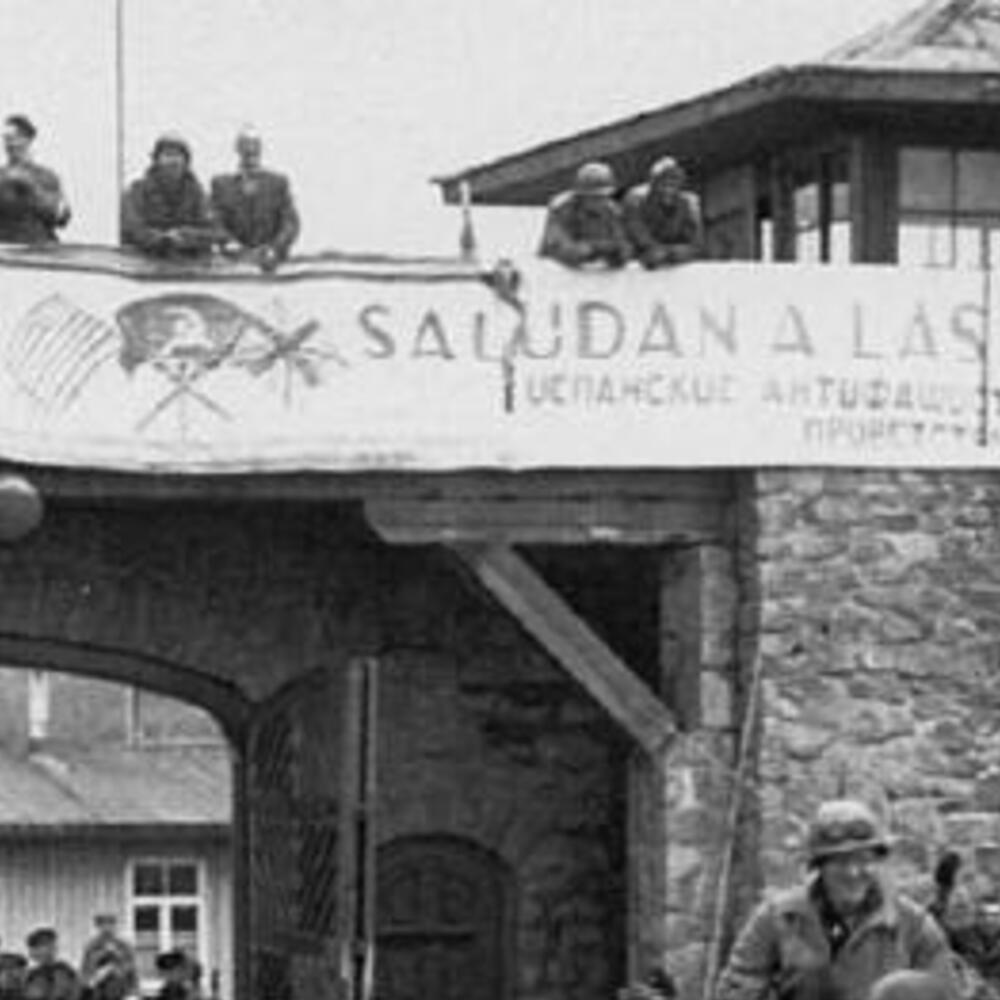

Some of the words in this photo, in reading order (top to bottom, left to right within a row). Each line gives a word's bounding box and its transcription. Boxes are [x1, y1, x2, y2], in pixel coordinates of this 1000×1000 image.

[358, 301, 738, 361] SALUDAN
[771, 303, 814, 358] A
[853, 300, 987, 363] LAS
